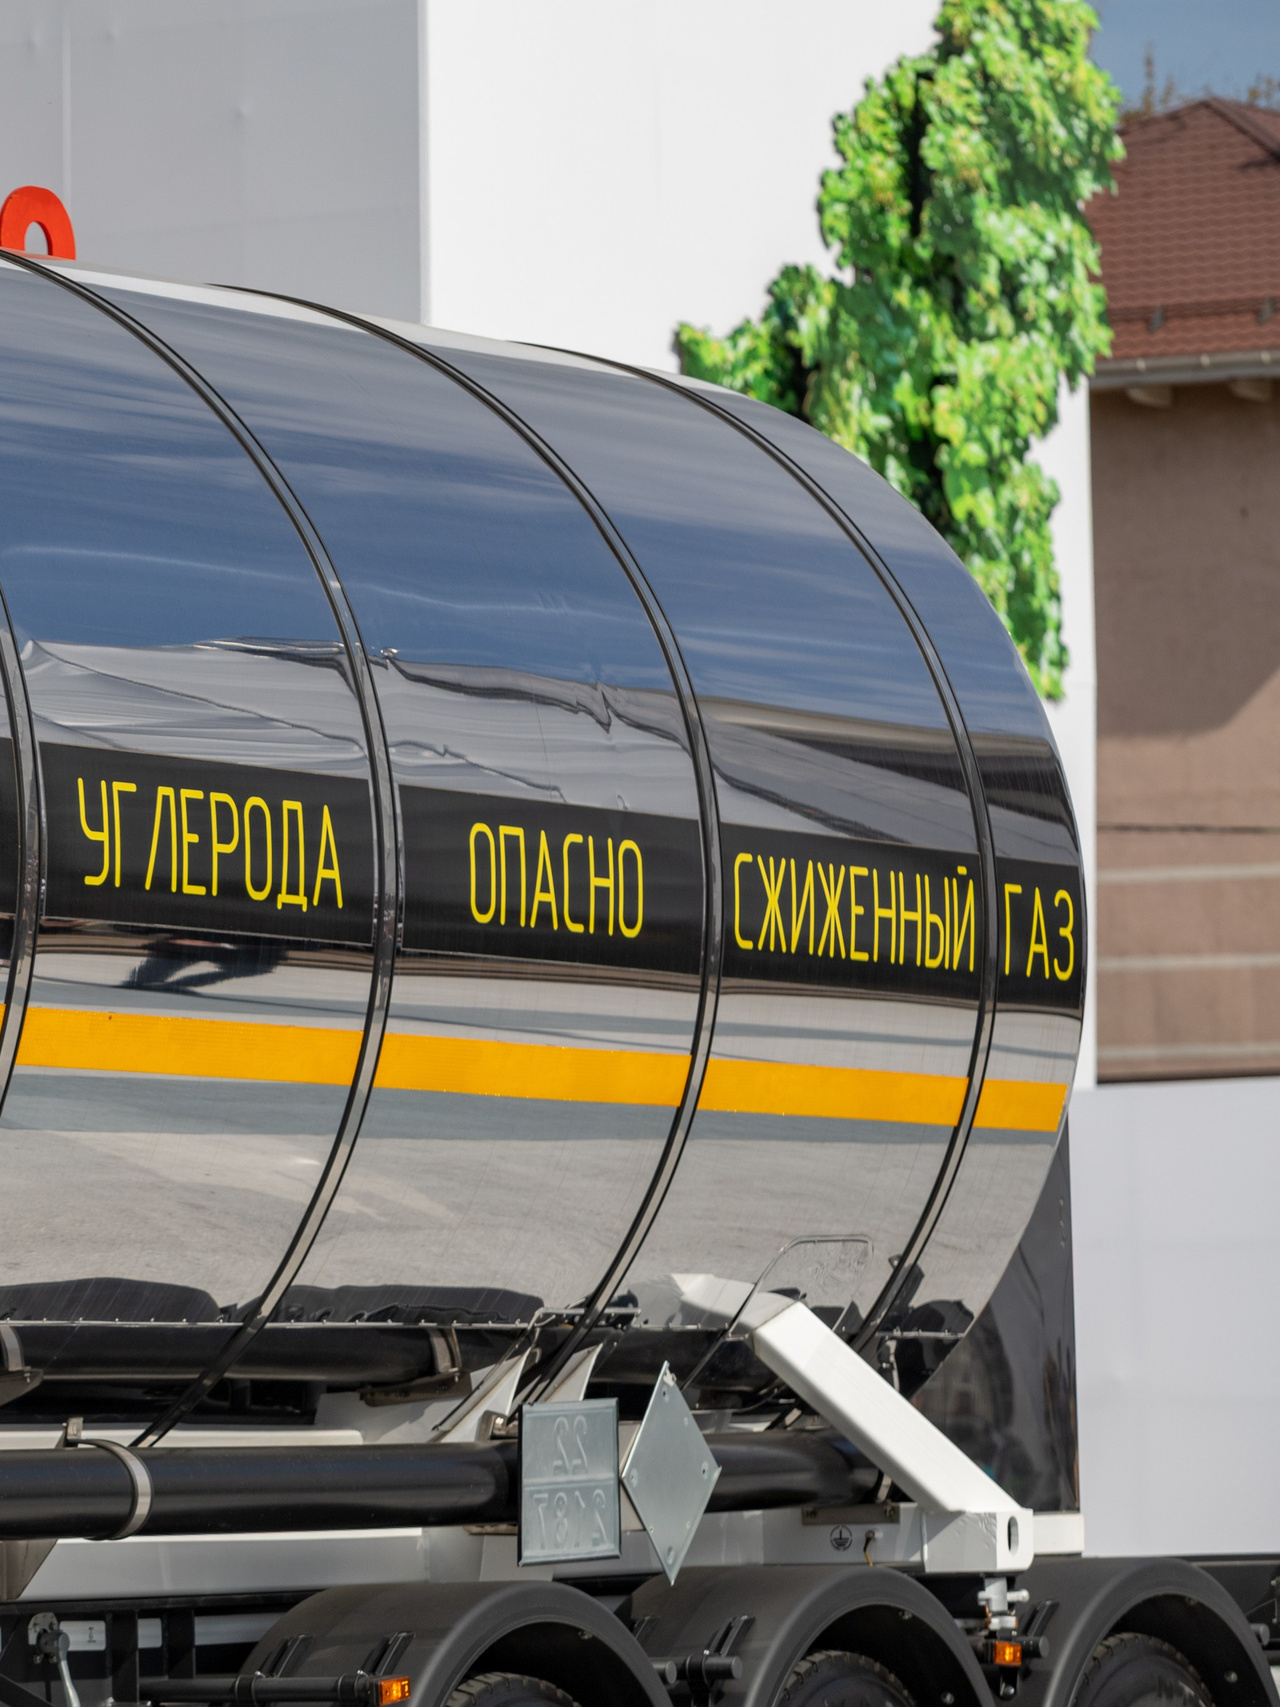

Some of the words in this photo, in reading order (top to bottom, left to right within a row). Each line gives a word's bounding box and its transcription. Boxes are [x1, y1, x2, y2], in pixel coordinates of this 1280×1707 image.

[76, 776, 344, 913] УГЛЕРОДА
[468, 821, 644, 939] ОПАСНО
[733, 851, 976, 973] СЖИЖЕННЫЙ
[1003, 882, 1075, 982] ГАЗ
